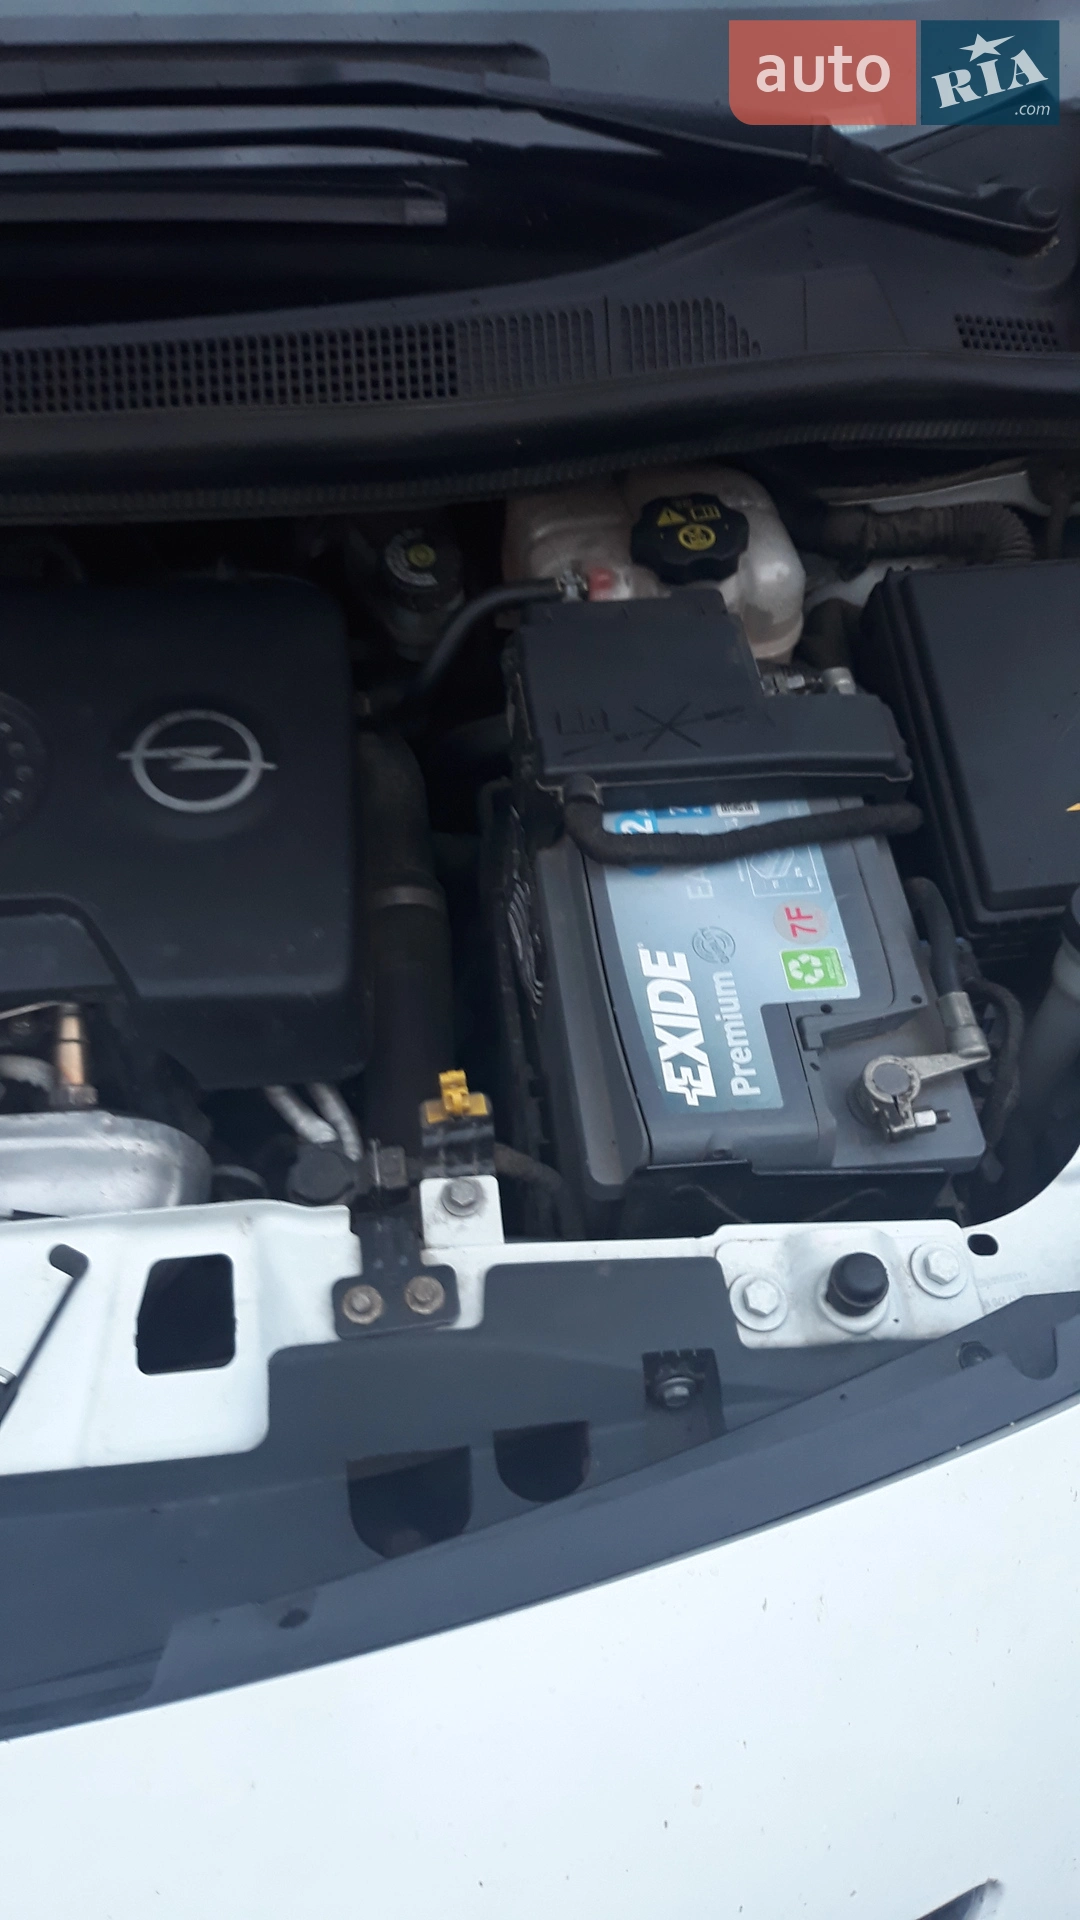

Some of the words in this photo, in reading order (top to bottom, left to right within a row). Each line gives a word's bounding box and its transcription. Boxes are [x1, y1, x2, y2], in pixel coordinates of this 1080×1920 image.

[620, 815, 654, 835] 2
[785, 907, 818, 938] 7F
[638, 948, 717, 1106] EXIDE
[712, 970, 761, 1097] Premium
